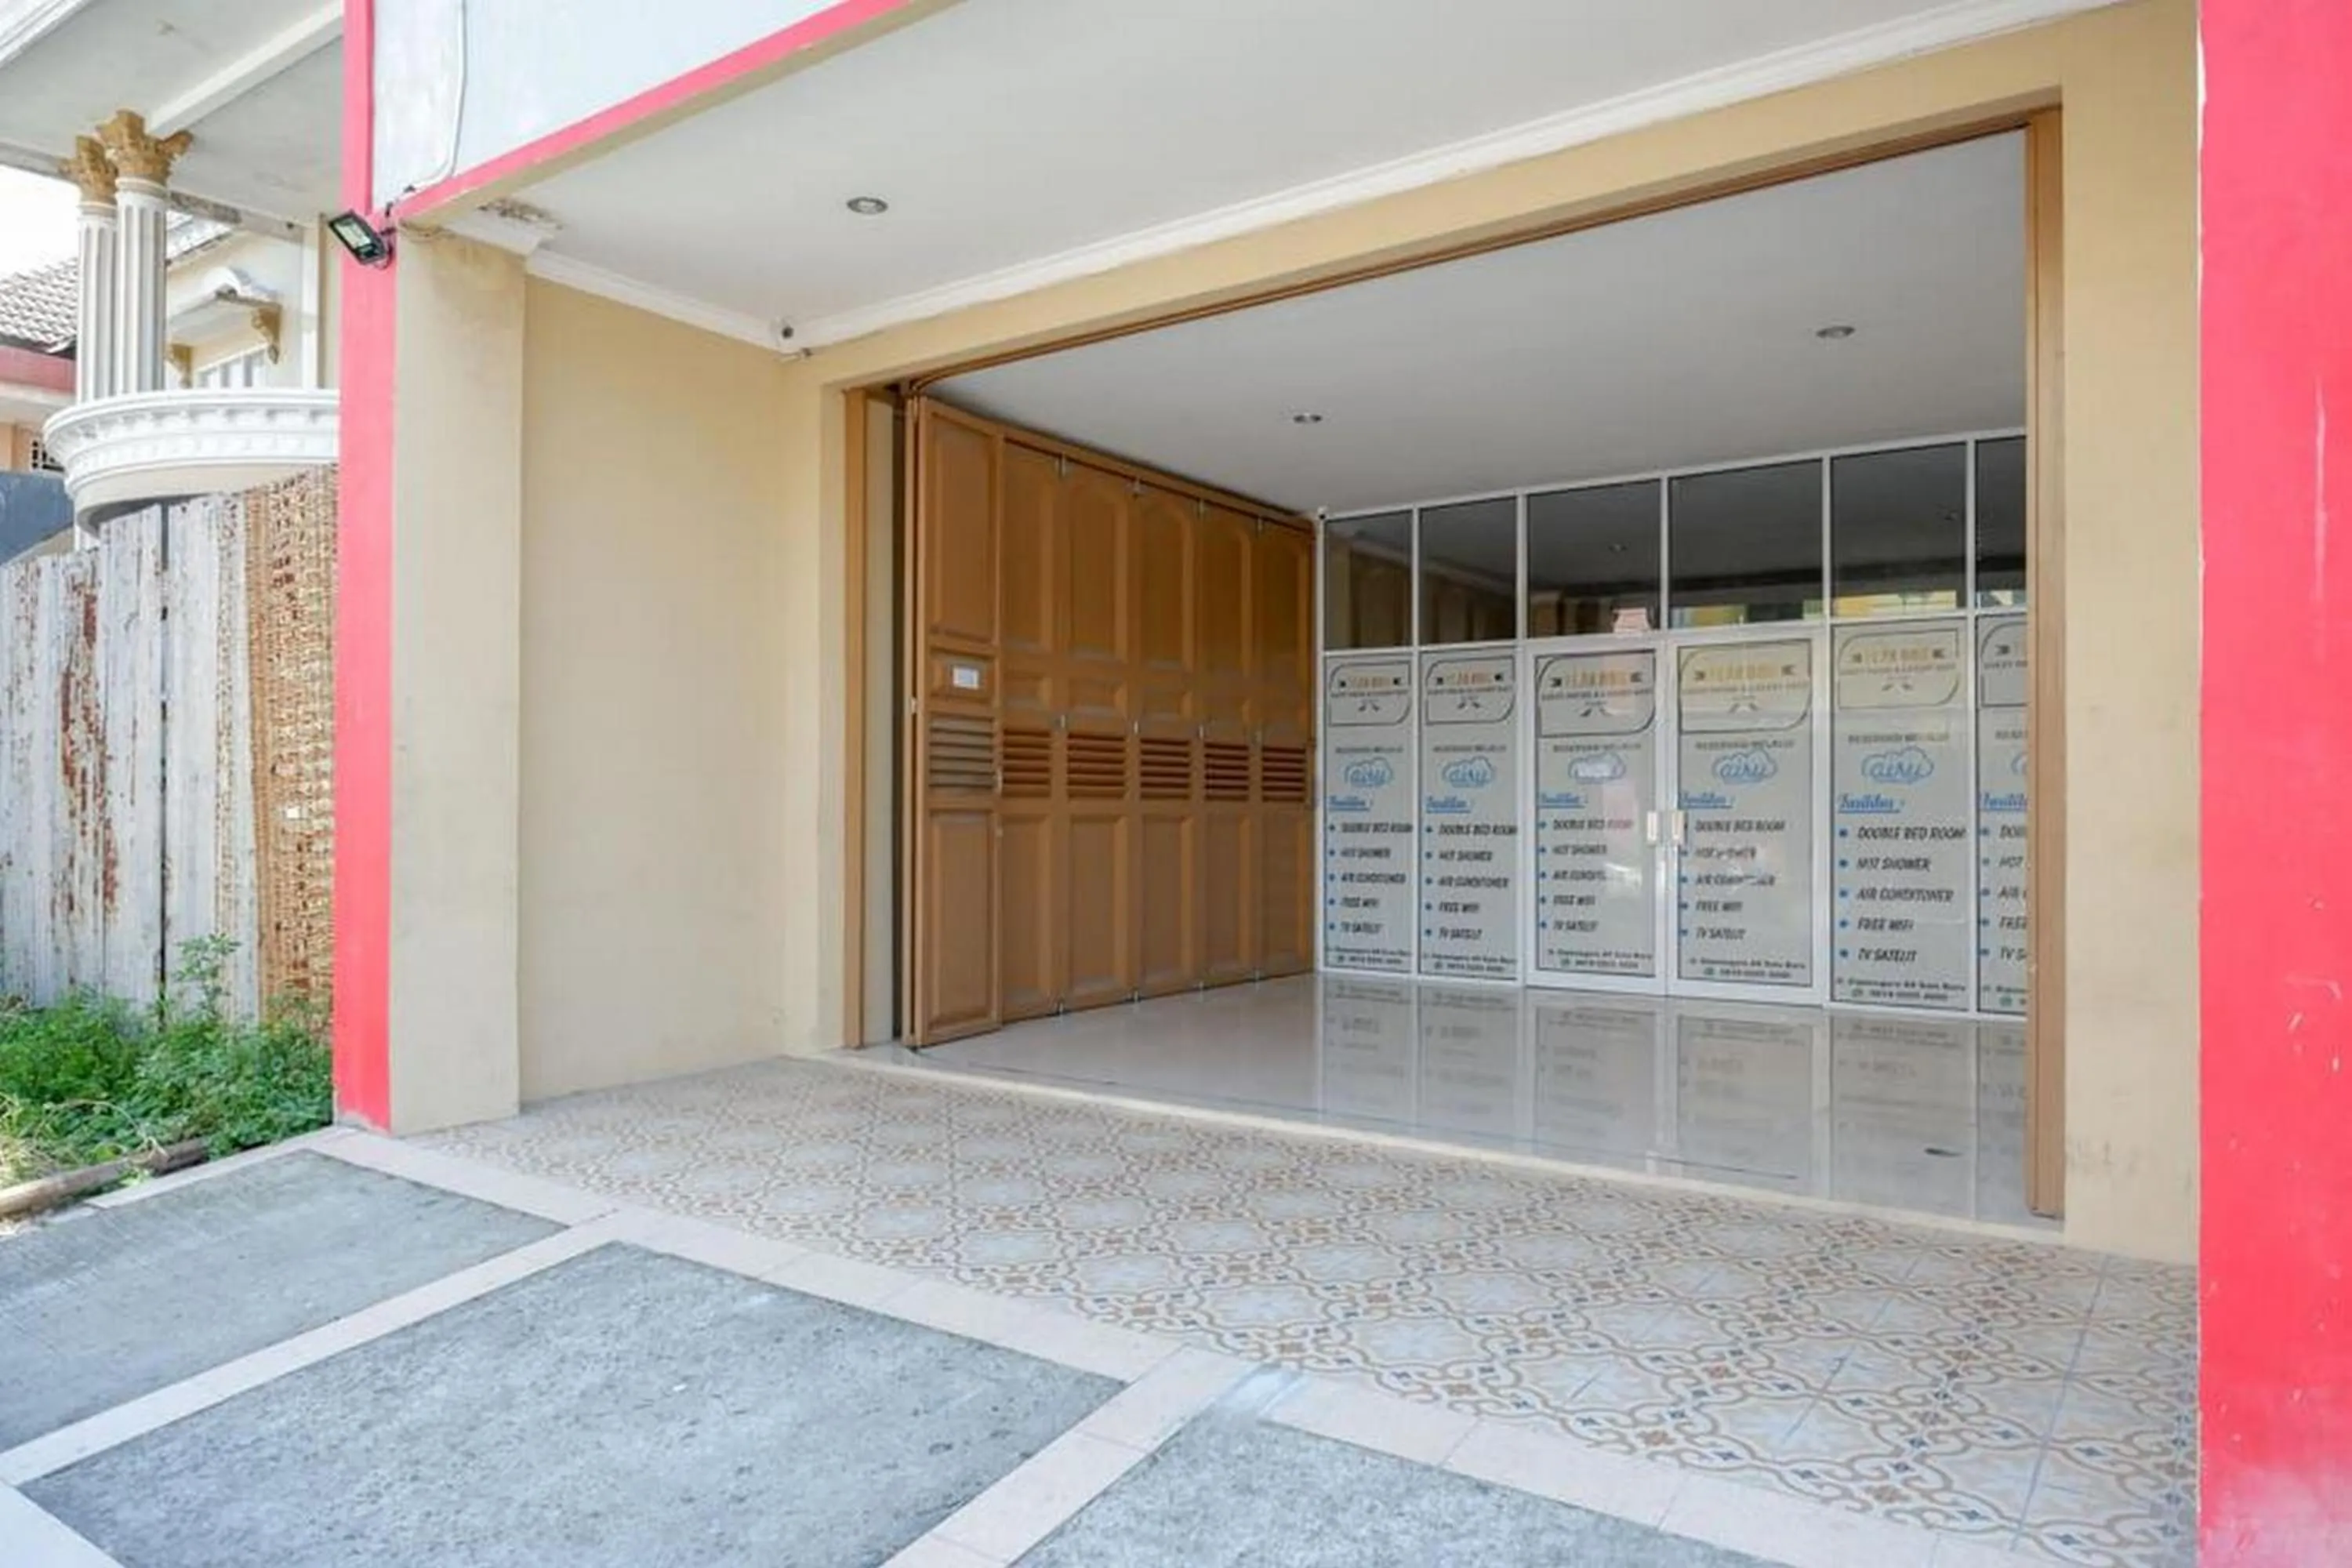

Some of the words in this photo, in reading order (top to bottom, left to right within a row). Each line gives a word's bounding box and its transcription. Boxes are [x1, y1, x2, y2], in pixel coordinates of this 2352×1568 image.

[1857, 826, 1900, 840] DOUBLE
[1903, 826, 1928, 840] BED
[1929, 826, 1967, 840] ROOM
[1882, 857, 1932, 872] SHOWER
[1857, 887, 1877, 901] AIR
[1857, 916, 1885, 931] FREE
[1857, 947, 1873, 961] TV
[2001, 946, 2015, 960] TV
